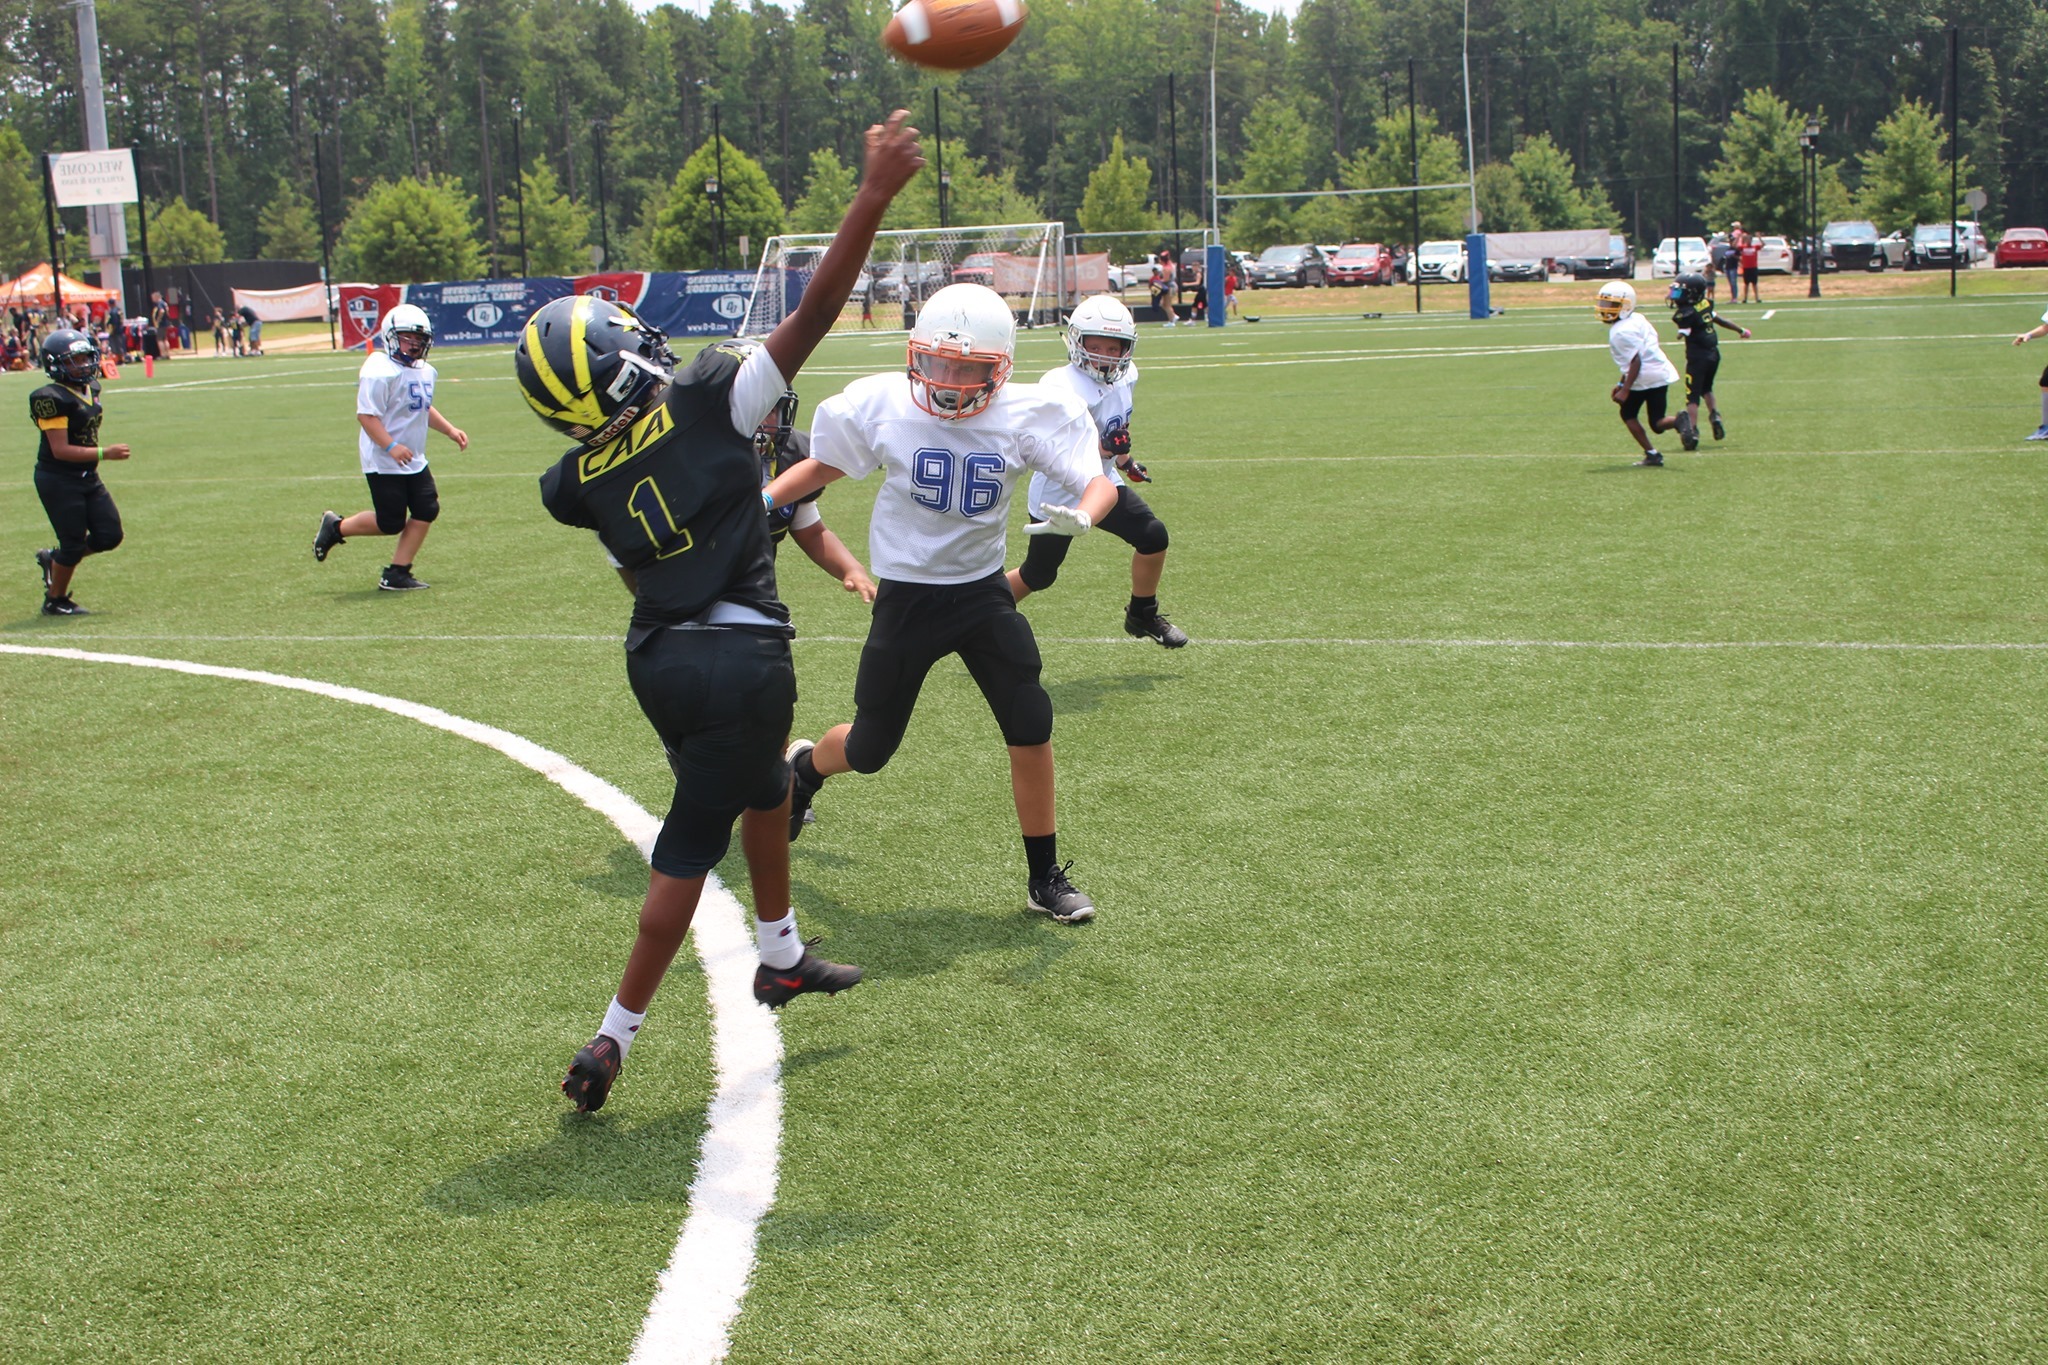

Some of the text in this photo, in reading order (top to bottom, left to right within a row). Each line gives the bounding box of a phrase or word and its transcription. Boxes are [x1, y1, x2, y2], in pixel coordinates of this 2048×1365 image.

[106, 363, 117, 376] G
[583, 409, 664, 477] CAA
[591, 408, 637, 447] Riddell
[911, 448, 1005, 517] 96
[627, 476, 693, 560] 1
